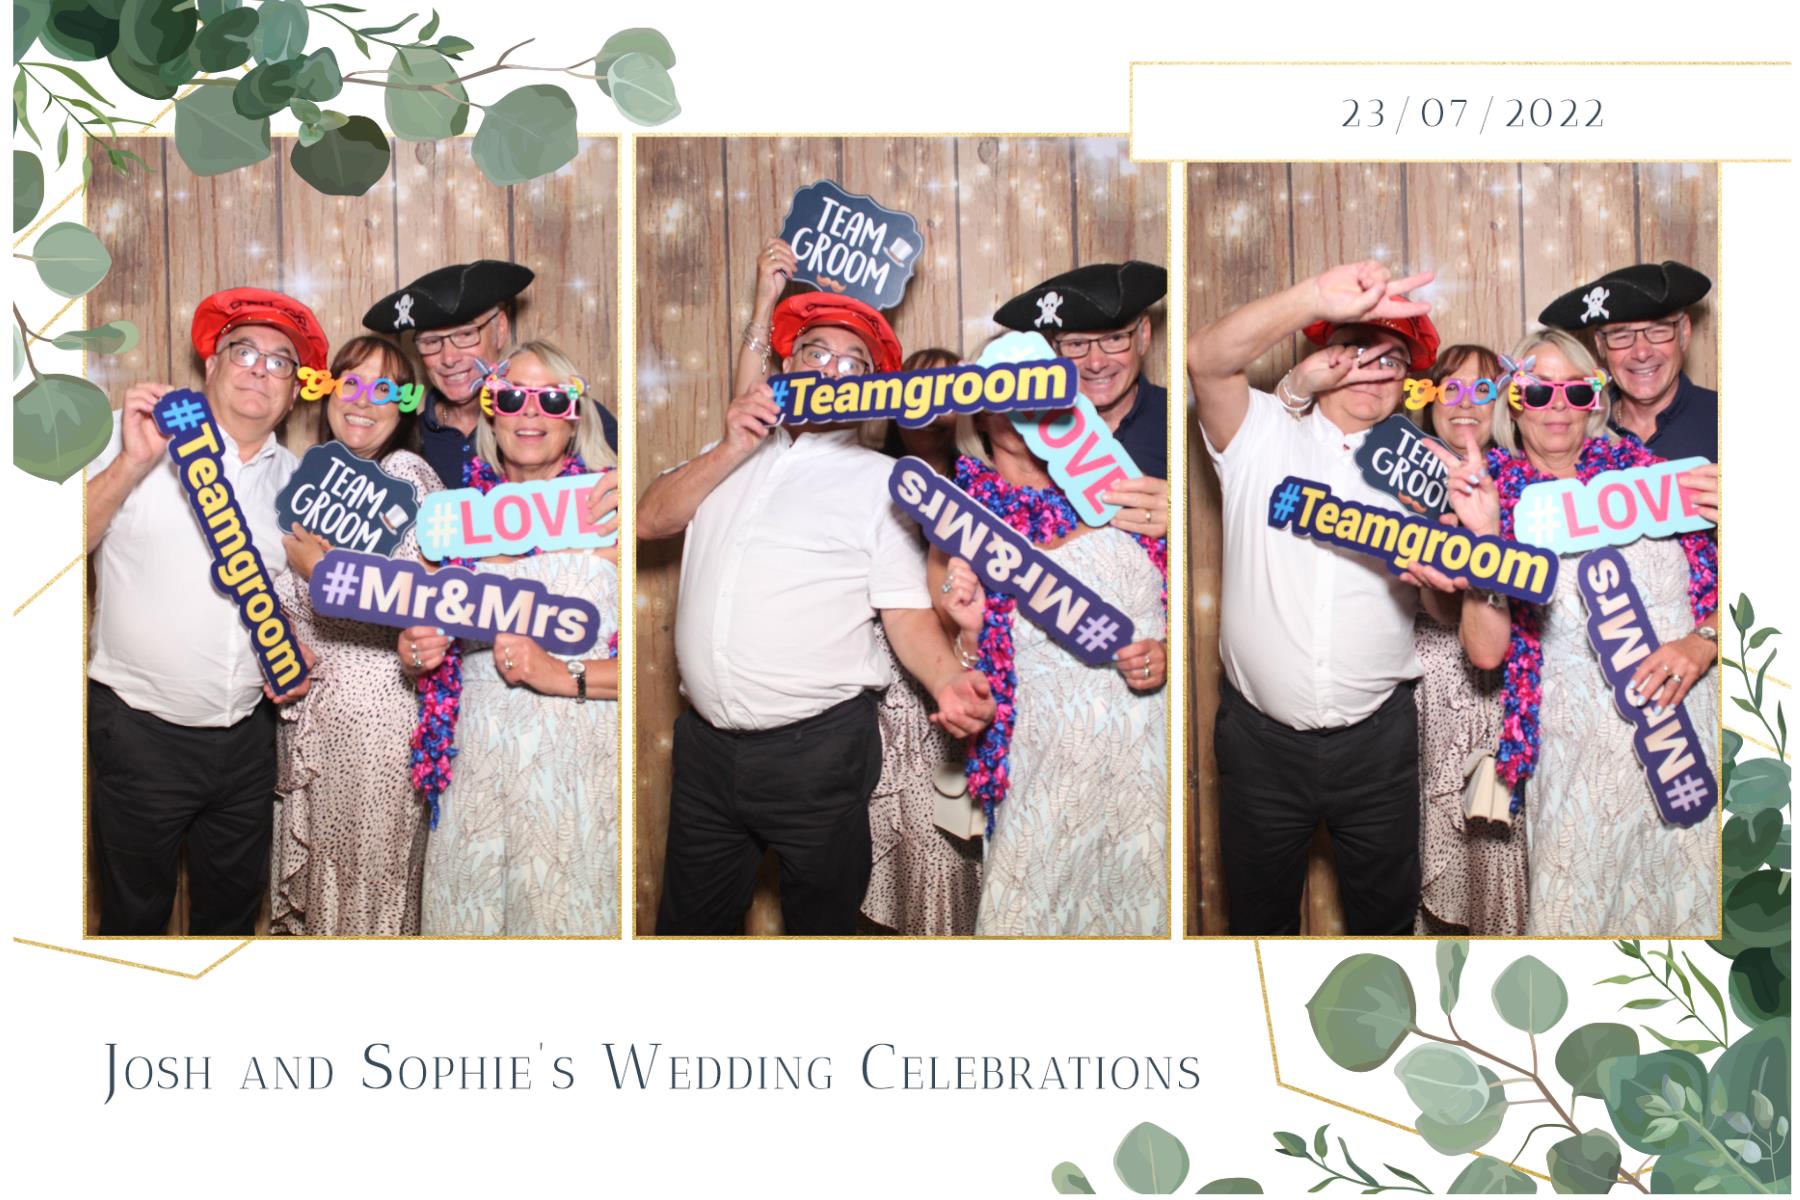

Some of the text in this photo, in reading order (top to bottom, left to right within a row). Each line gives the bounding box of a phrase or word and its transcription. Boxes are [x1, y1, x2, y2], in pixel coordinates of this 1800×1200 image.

[817, 197, 887, 255] TEAM
[791, 227, 890, 295] GROOM
[772, 364, 1067, 419] #Teamgroom
[320, 456, 388, 519] TEAM
[1372, 447, 1448, 512] GROO
[162, 397, 302, 687] #Teamgroom
[291, 483, 383, 554] GROOM
[1273, 483, 1551, 594] #Teamgroom
[897, 469, 1119, 651] #Mr&Mrs
[322, 560, 590, 643] #Mr&Mrs
